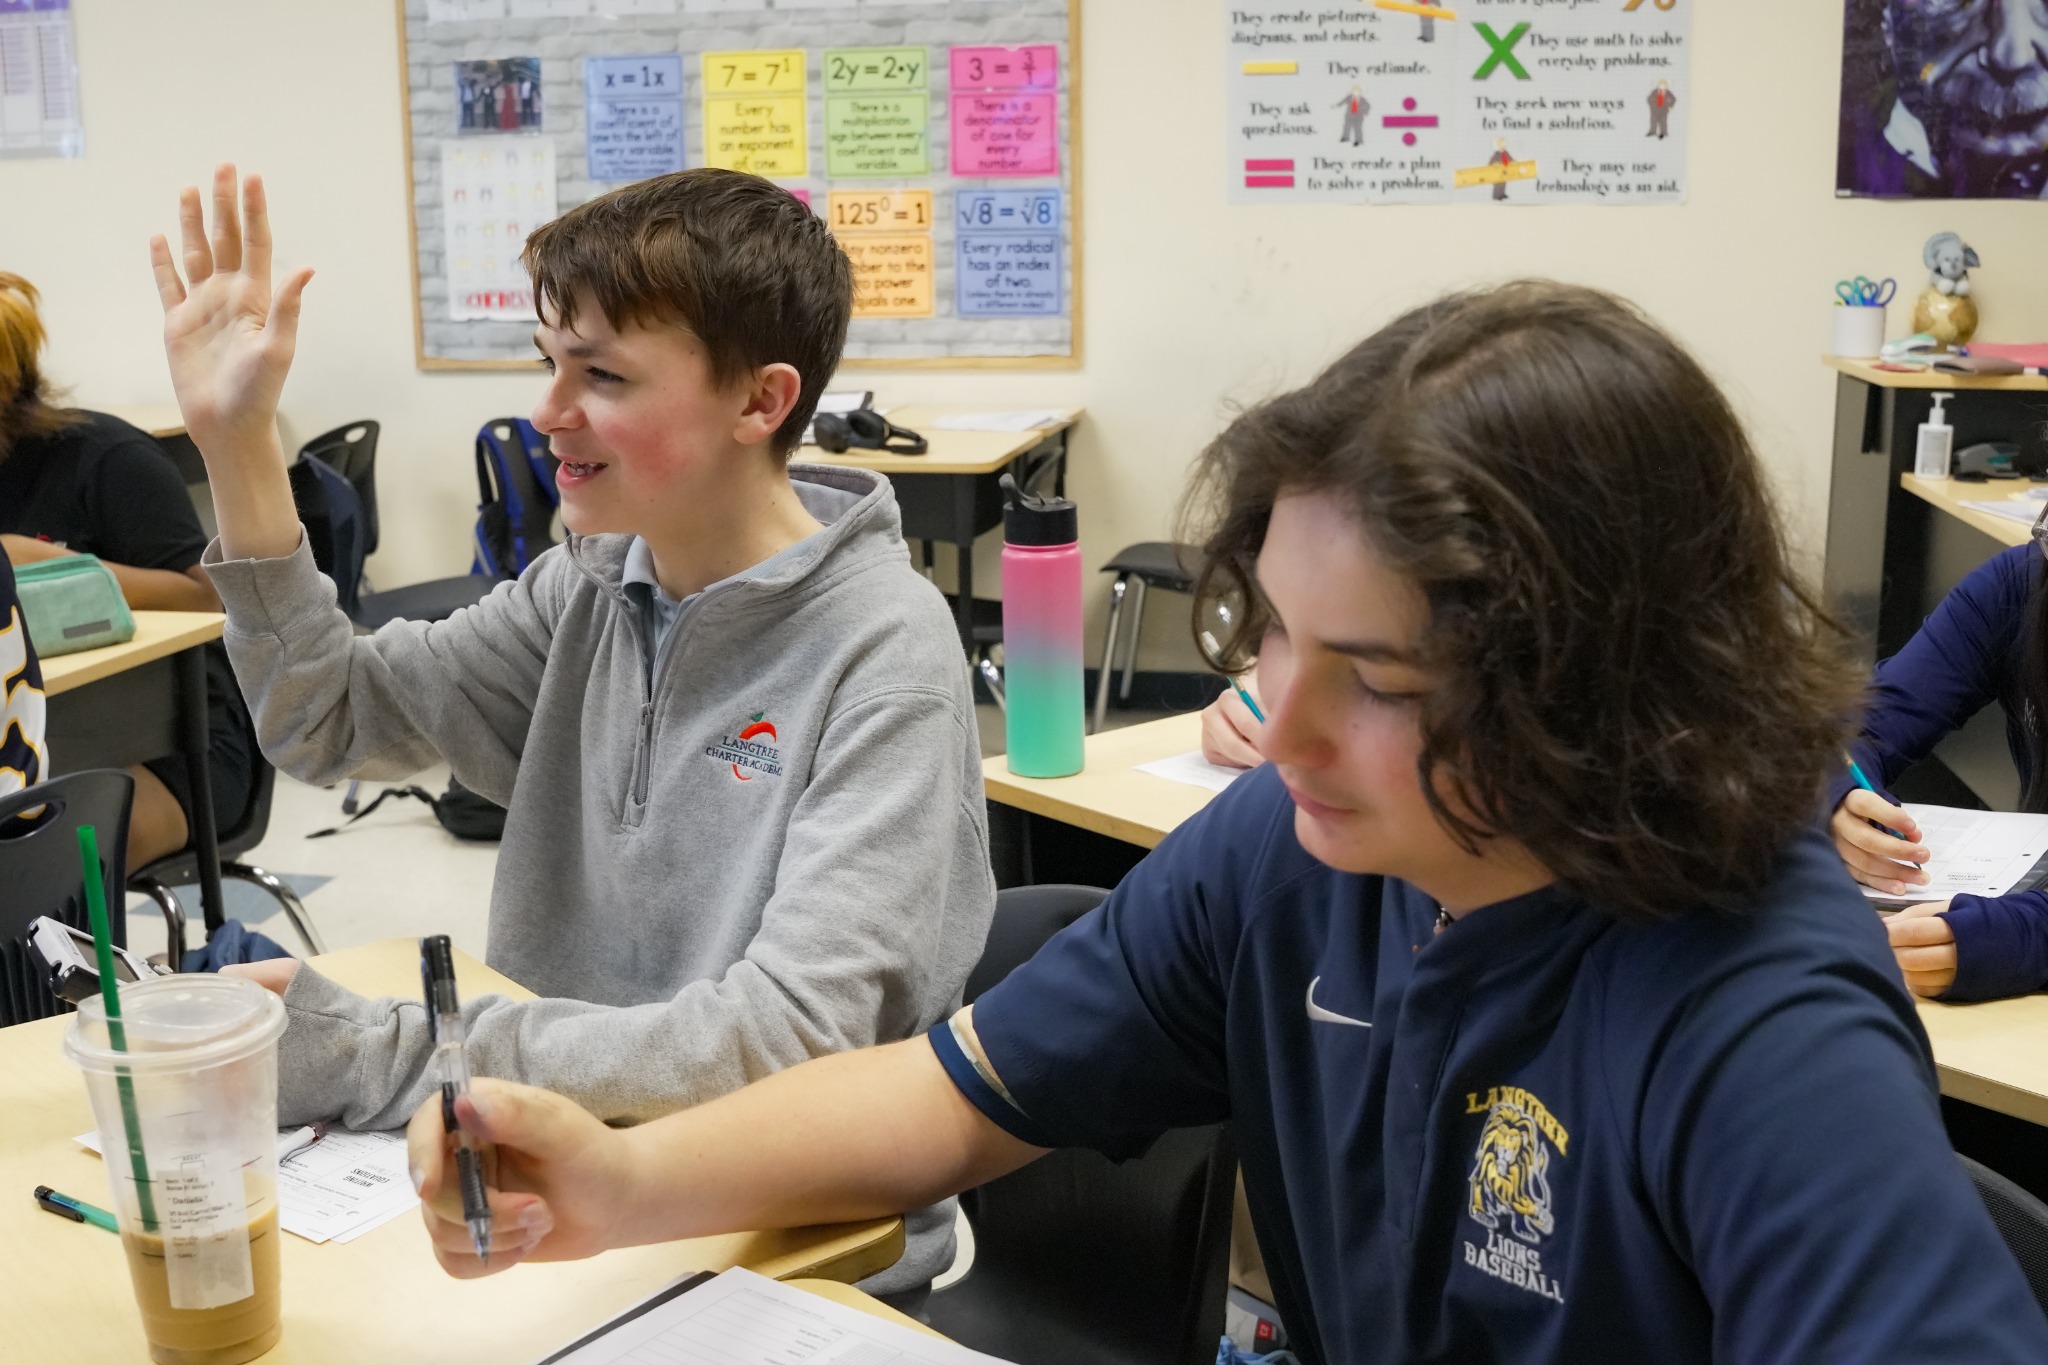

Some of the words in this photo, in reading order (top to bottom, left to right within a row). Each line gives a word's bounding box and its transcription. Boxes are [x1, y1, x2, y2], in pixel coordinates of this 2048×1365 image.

[1231, 11, 1263, 27] They
[1270, 10, 1312, 24] create
[1302, 30, 1328, 42] and
[1332, 30, 1381, 43] charts.
[1530, 34, 1559, 50] They
[1565, 36, 1588, 46] use
[1594, 34, 1626, 46] math
[1629, 34, 1644, 46] to
[1648, 32, 1683, 46] solve
[969, 57, 984, 82] 3
[1327, 62, 1360, 78] They
[1366, 61, 1432, 75] estimate.
[1538, 56, 1598, 71] everyday
[1603, 53, 1673, 71] problems.
[605, 71, 616, 87] x
[641, 65, 665, 88] 1x
[721, 65, 737, 87] 7
[831, 57, 860, 86] 2y
[735, 103, 774, 117] Every
[851, 102, 877, 112] There
[882, 102, 890, 112] is
[893, 104, 901, 112] a
[974, 99, 1006, 112] There
[1011, 99, 1019, 111] is
[1023, 100, 1032, 111] a
[1250, 102, 1282, 119] They
[1288, 102, 1311, 115] ask
[1474, 97, 1508, 113] They
[1514, 96, 1547, 109] seek
[1553, 99, 1584, 109] new
[1588, 98, 1625, 113] ways
[660, 115, 674, 128] of
[719, 122, 764, 134] number
[768, 121, 791, 133] has
[842, 115, 911, 128] multiplication
[964, 114, 1042, 126] denominator
[1482, 117, 1497, 130] to
[1502, 117, 1531, 129] find
[1536, 121, 1544, 130] a
[1549, 117, 1616, 130] solution.
[612, 131, 624, 142] to
[626, 130, 642, 142] the
[646, 129, 663, 141] left
[666, 128, 679, 140] of
[851, 130, 891, 141] between
[896, 131, 924, 142] every
[971, 129, 986, 142] of
[989, 131, 1012, 142] one
[1015, 128, 1035, 141] for
[1241, 123, 1318, 139] questions.
[719, 140, 734, 151] an
[738, 139, 794, 153] exponent
[836, 144, 895, 156] coefficient
[900, 144, 919, 156] and
[985, 144, 1020, 156] every
[733, 156, 749, 169] of
[1313, 157, 1345, 174] They
[1351, 157, 1393, 170] create
[1399, 161, 1406, 170] a
[1410, 156, 1441, 173] plan
[1562, 159, 1593, 176] They
[1600, 162, 1625, 176] may
[1632, 161, 1657, 173] use
[1307, 177, 1323, 190] to
[1327, 176, 1365, 190] solve
[1369, 180, 1377, 190] a
[1381, 176, 1445, 194] problem.
[1536, 179, 1611, 196] technology
[1616, 182, 1631, 193] as
[1635, 182, 1652, 193] an
[1656, 179, 1681, 193] aid.
[915, 202, 925, 224] 1
[869, 244, 923, 255] nonzero
[962, 240, 1001, 256] Every
[1006, 238, 1054, 254] radical
[887, 262, 901, 273] to
[905, 261, 927, 272] the
[967, 259, 992, 271] has
[996, 260, 1011, 271] an
[1015, 258, 1050, 271] index
[874, 278, 914, 291] power
[985, 275, 1002, 288] of
[855, 294, 888, 310] quals
[722, 736, 779, 759] LANGTREE
[706, 747, 749, 767] CHARTER
[1486, 1228, 1542, 1273] LIONS
[1464, 1240, 1565, 1304] BASEBALL
